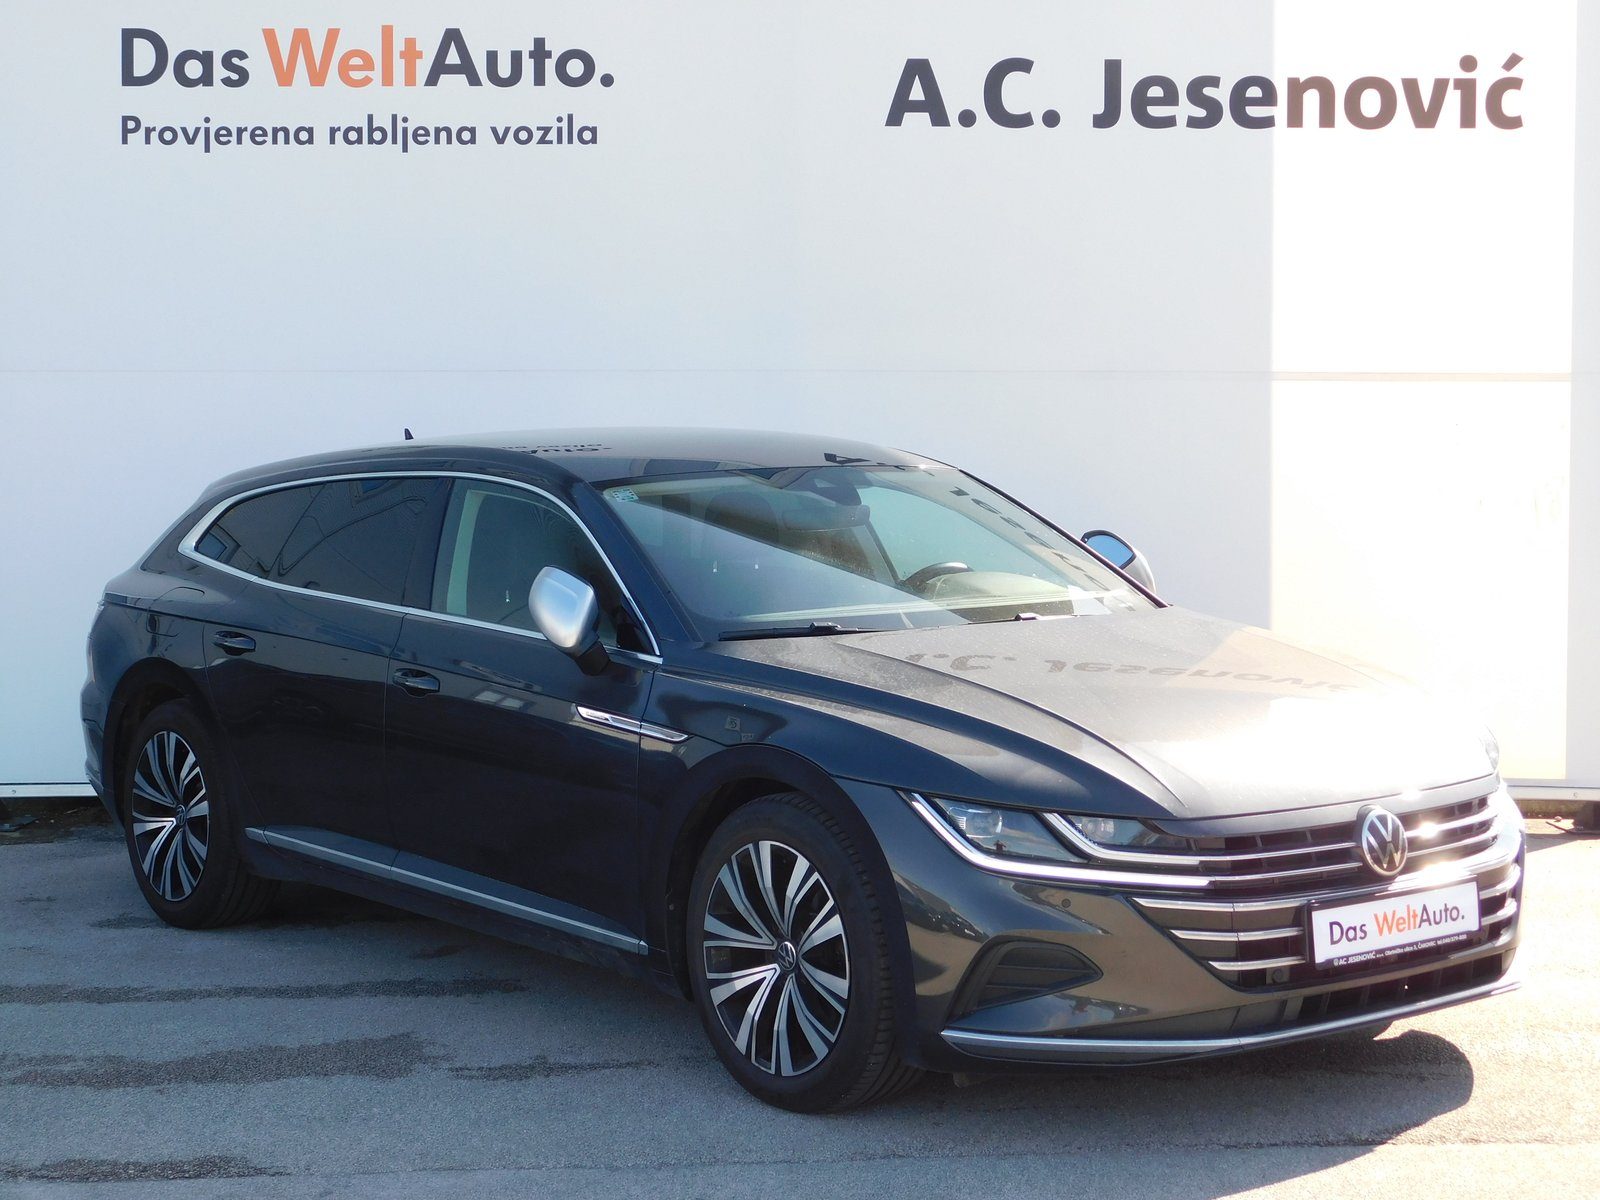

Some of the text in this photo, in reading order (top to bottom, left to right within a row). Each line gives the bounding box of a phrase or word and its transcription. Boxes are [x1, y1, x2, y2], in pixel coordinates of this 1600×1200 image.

[121, 25, 615, 88] Das WeltAuto.
[885, 54, 1523, 129] A.C. Jesenović
[122, 114, 598, 153] Provjerena rabljena vozila
[1329, 903, 1465, 946] Das WeltAuto.
